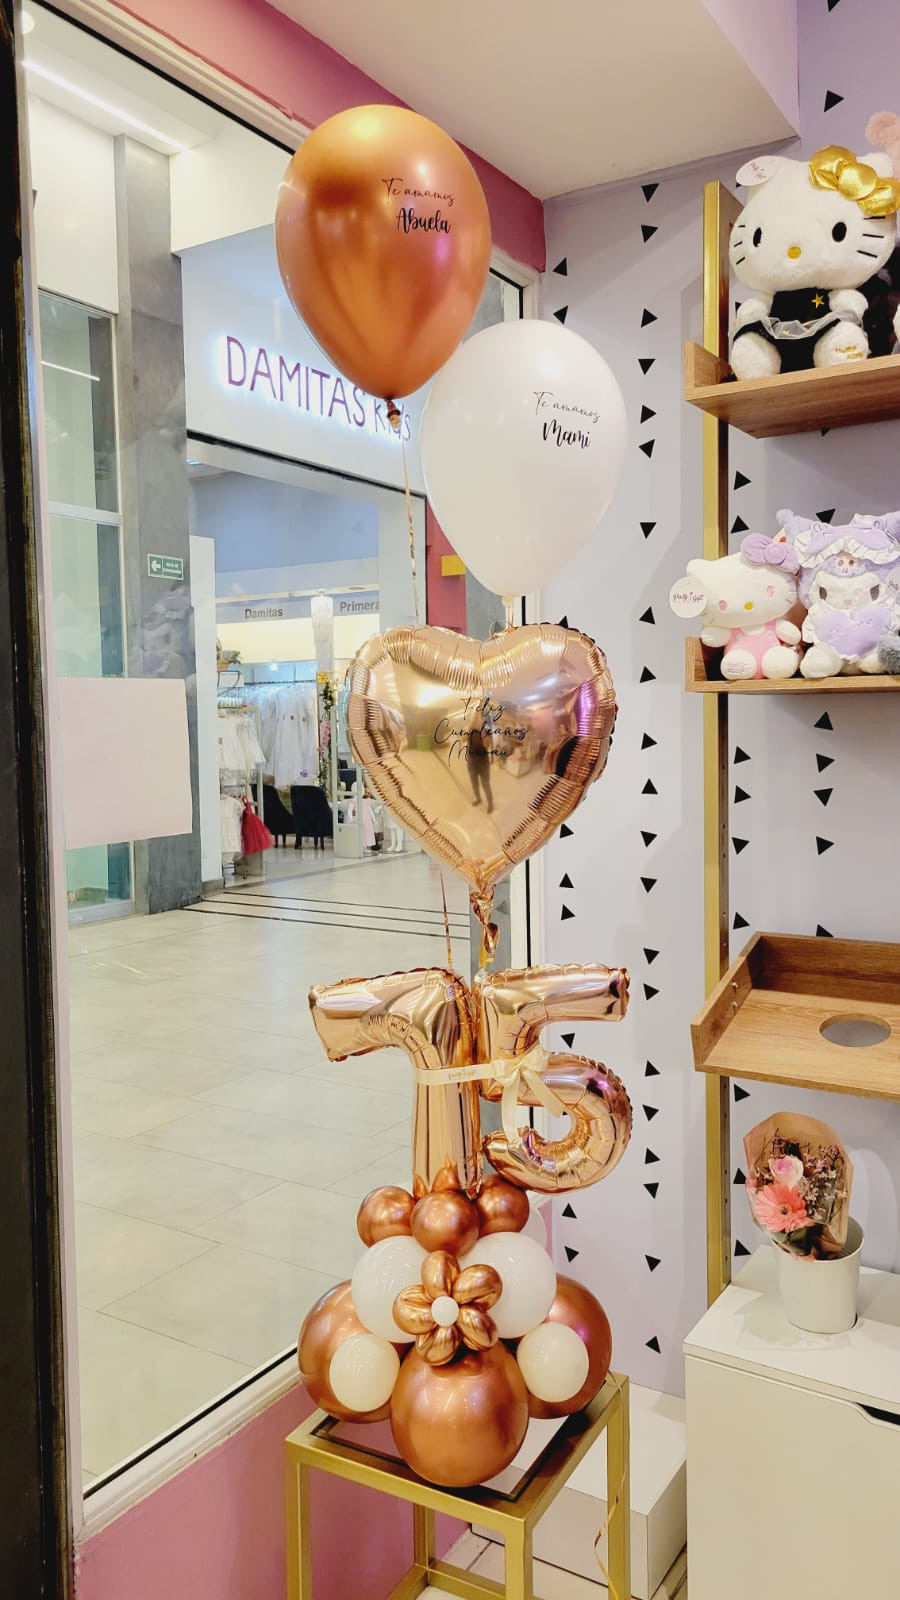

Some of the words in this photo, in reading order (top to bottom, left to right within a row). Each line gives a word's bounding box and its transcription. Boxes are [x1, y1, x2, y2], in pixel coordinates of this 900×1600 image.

[381, 177, 404, 199] Te
[404, 187, 455, 207] amamos
[395, 207, 452, 234] Abuela
[226, 335, 367, 427] DAMITAS
[533, 391, 554, 415] Te
[553, 402, 600, 424] amamos
[542, 418, 592, 449] Mami
[244, 607, 284, 619] Damitas
[460, 696, 508, 722] Feliz
